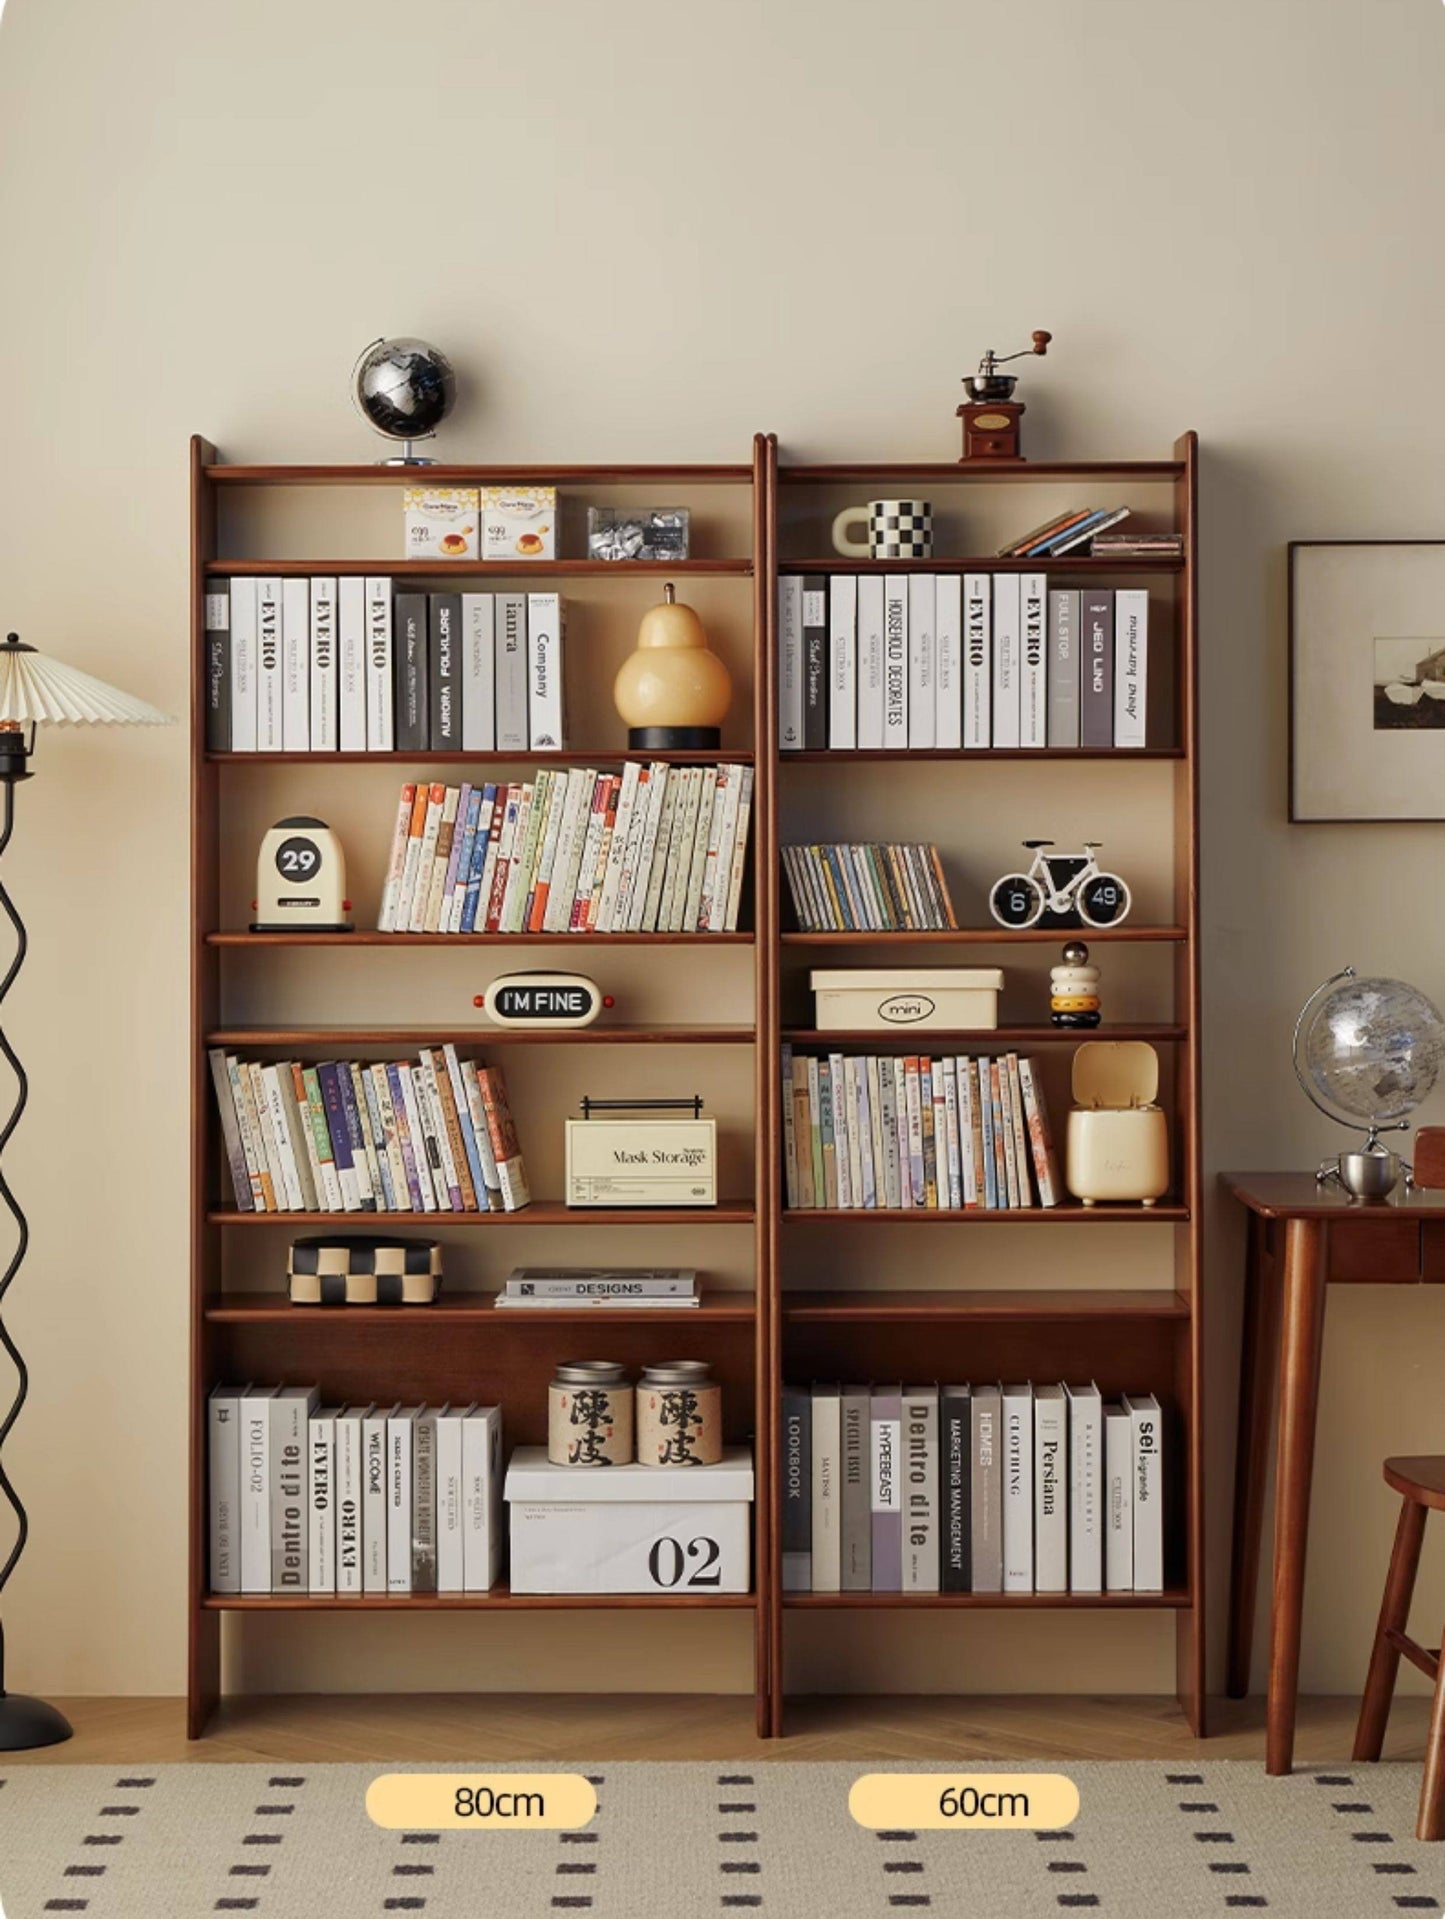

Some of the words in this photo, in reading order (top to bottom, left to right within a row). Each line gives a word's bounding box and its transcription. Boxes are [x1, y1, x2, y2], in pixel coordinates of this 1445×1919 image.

[317, 600, 330, 668] EVERO
[372, 600, 386, 668] EVERO
[888, 599, 902, 660] HOUSEHOLD
[969, 599, 983, 666] EVERO
[1027, 598, 1040, 666] EVERO
[1059, 594, 1069, 623] FULL
[262, 601, 275, 670] EVERO
[1093, 622, 1104, 652] JED
[535, 633, 550, 698] Company
[1093, 658, 1104, 692] LIND
[441, 686, 450, 737] AURORA
[888, 665, 902, 726] DECORATES
[282, 850, 316, 871] 29
[1010, 893, 1026, 912] 6
[1091, 887, 1117, 905] 49
[504, 992, 530, 1011] I'M
[535, 992, 582, 1011] FINE
[889, 1002, 922, 1015] mini
[613, 1150, 649, 1164] Mask
[652, 1150, 706, 1167] Storage
[576, 1283, 643, 1294] DESIGNS
[249, 1419, 263, 1493] FOLIO-02
[281, 1445, 301, 1467] te
[846, 1409, 860, 1451] SPECIAL
[909, 1406, 929, 1484] Dentro
[950, 1419, 961, 1485] MARKETING
[979, 1413, 993, 1466] HOMES
[1010, 1415, 1020, 1495] CLOTHING
[1139, 1422, 1157, 1454] sei
[314, 1442, 328, 1510] EVERO
[369, 1432, 381, 1495] WELCOME
[789, 1416, 800, 1498] LOOKBOOK
[847, 1456, 860, 1484] ISSUE
[879, 1424, 891, 1505] HYPEBEAST
[1042, 1441, 1058, 1515] Persiana
[1137, 1456, 1151, 1502] sigrande
[280, 1473, 301, 1497] di
[910, 1495, 929, 1517] di
[280, 1508, 301, 1586] Dentro
[342, 1500, 355, 1569] EVERO
[910, 1525, 929, 1546] te
[950, 1489, 961, 1569] MANAGEMENT
[648, 1536, 722, 1588] 02
